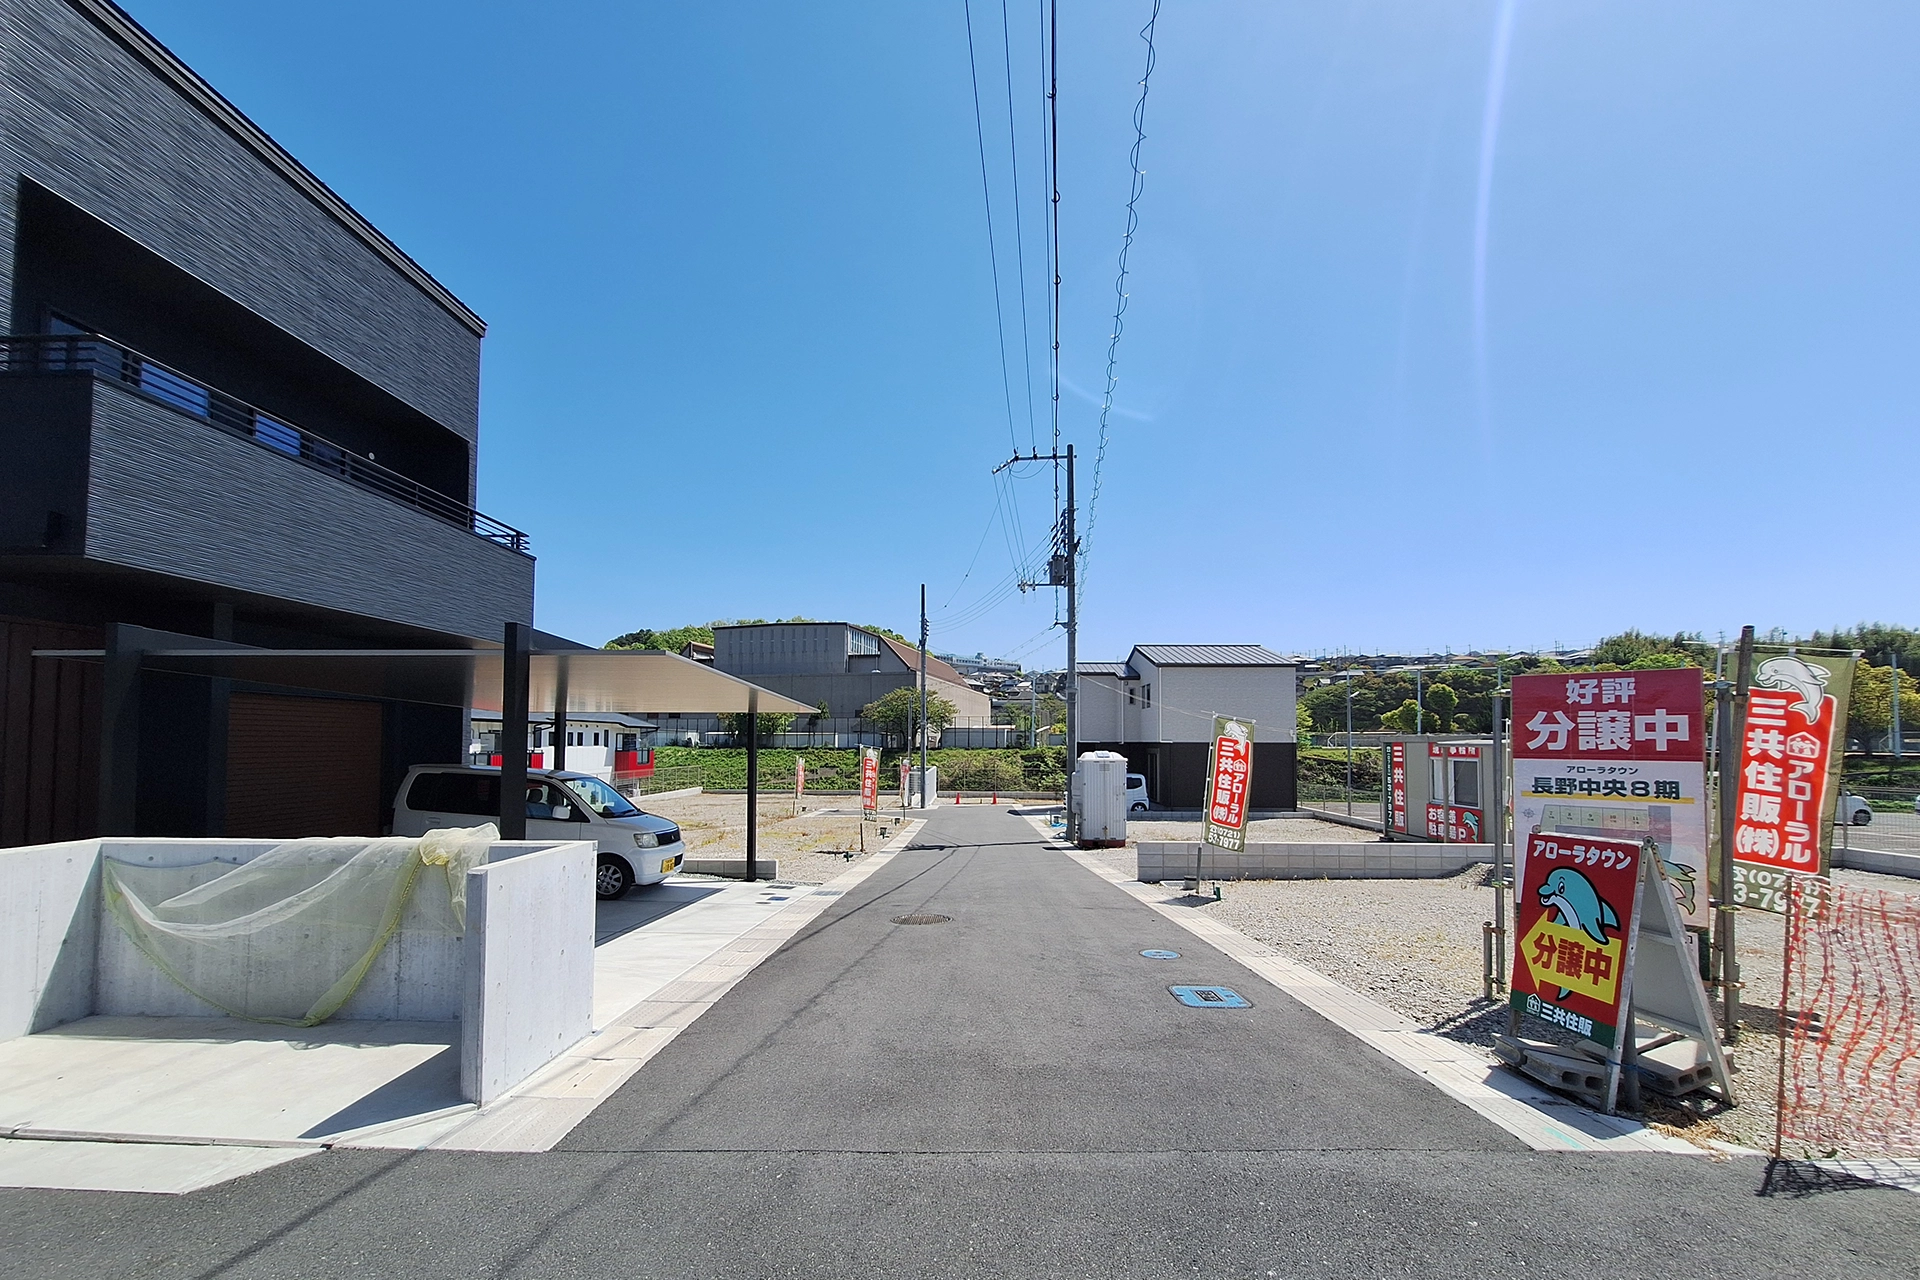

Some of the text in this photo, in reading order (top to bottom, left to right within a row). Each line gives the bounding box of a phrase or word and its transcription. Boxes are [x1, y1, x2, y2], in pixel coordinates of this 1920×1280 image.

[1566, 677, 1636, 705] 好評
[1525, 708, 1690, 751] 分譲中
[1393, 746, 1405, 827] 三共住販
[1532, 776, 1681, 800] 長野中央8期
[1566, 765, 1639, 775] アローラタウン
[1736, 696, 1787, 860] 三共住販(株)
[1228, 773, 1245, 824] アローラル
[1781, 760, 1815, 864] アローラル
[1533, 840, 1632, 870] アローラタウン
[1532, 932, 1614, 986] 分譲中
[1540, 1002, 1594, 1037] 三共住販
